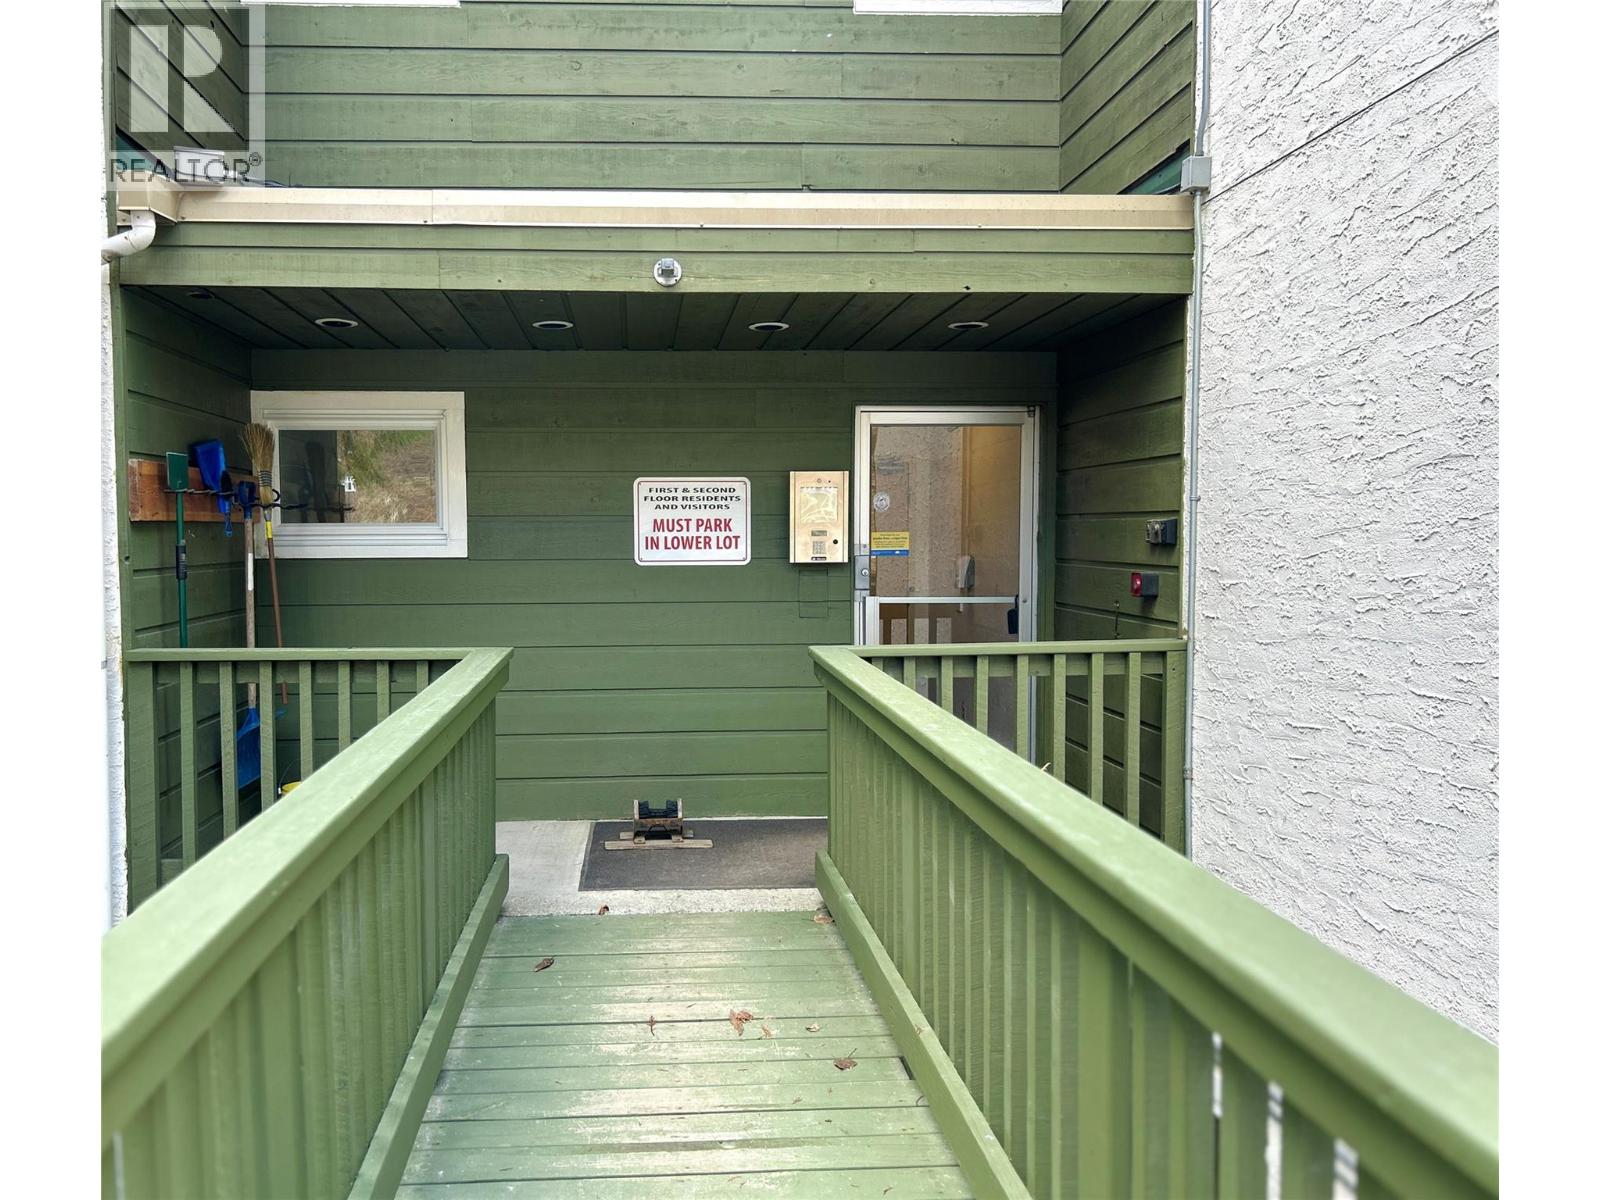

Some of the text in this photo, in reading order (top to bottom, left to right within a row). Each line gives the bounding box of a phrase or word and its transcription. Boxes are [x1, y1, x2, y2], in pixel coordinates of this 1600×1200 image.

[652, 518, 732, 532] MUST PARK
[645, 536, 740, 550] IN LOWER LOT
